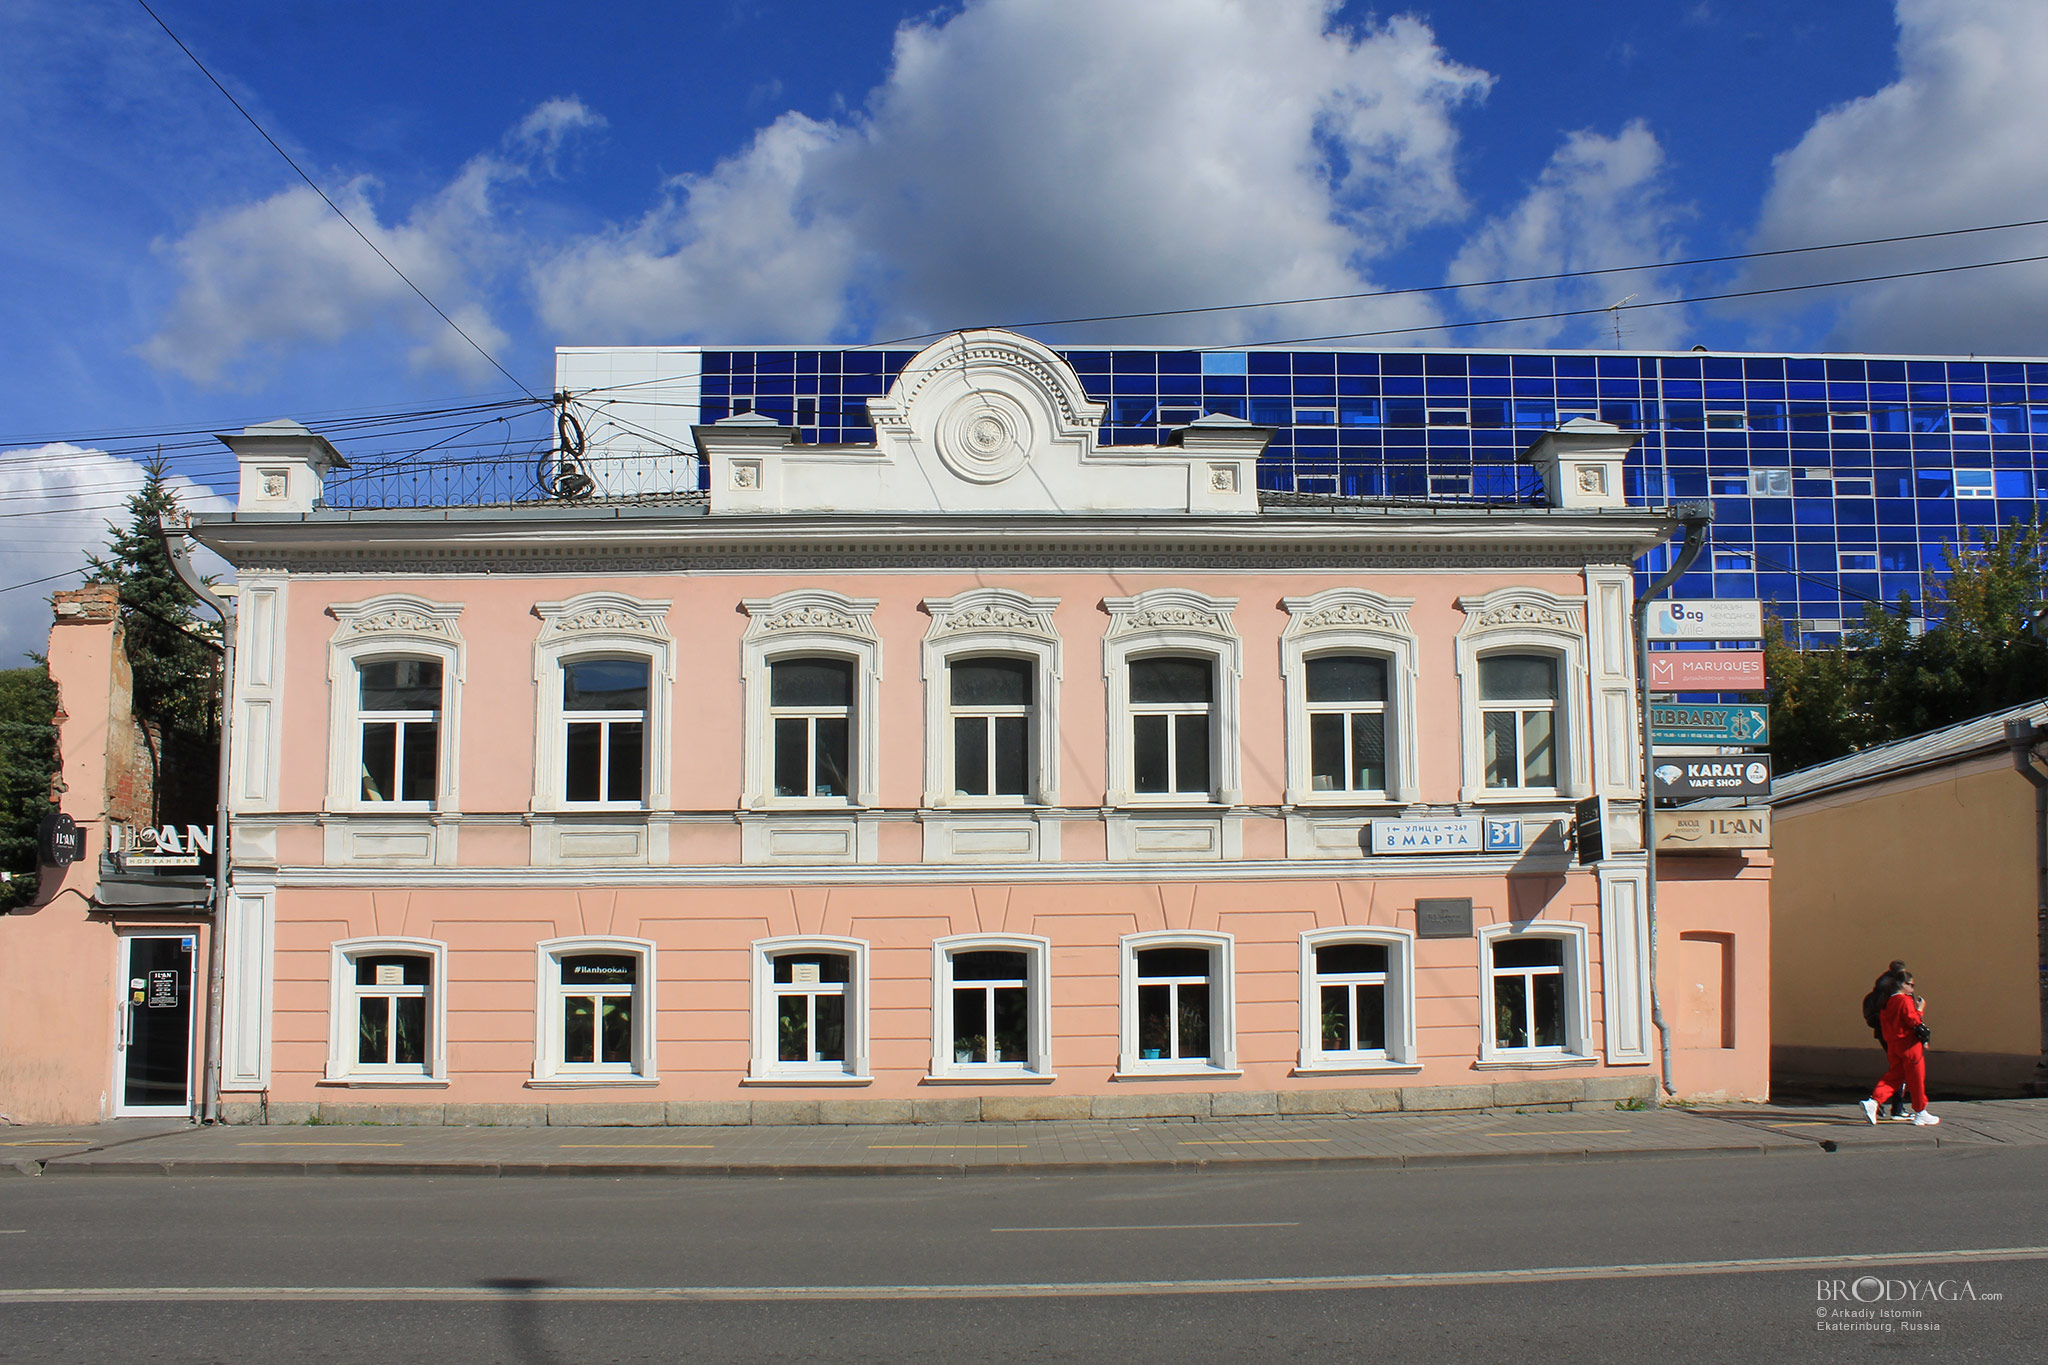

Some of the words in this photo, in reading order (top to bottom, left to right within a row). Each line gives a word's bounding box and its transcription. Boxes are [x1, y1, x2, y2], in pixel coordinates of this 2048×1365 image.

[1670, 603, 1704, 622] Bag
[1677, 624, 1704, 635] Ville
[1682, 661, 1760, 672] MARUQUES
[1687, 763, 1745, 777] KARAT
[1752, 764, 1760, 774] 2
[1688, 779, 1715, 787] VAPE
[1716, 778, 1742, 787] SHOP
[1386, 835, 1395, 846] 8
[1402, 833, 1468, 846] МАРТА
[1491, 822, 1518, 845] 31
